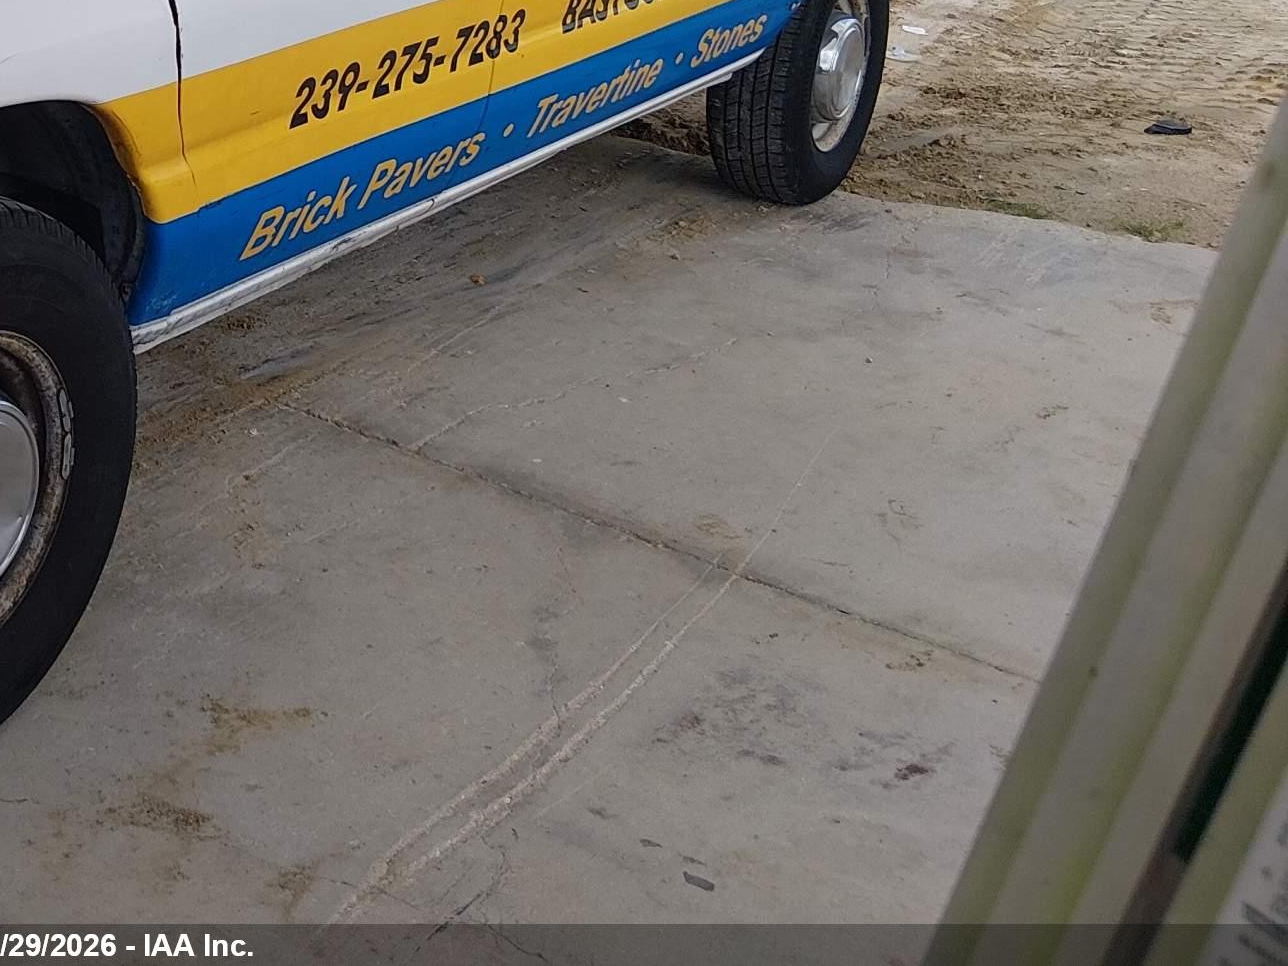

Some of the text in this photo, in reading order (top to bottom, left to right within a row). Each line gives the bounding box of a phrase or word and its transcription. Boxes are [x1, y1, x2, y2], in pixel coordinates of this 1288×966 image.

[239, 14, 768, 261] Brick Pavers Travertine Stones
[289, 8, 526, 129] 239-275-7283
